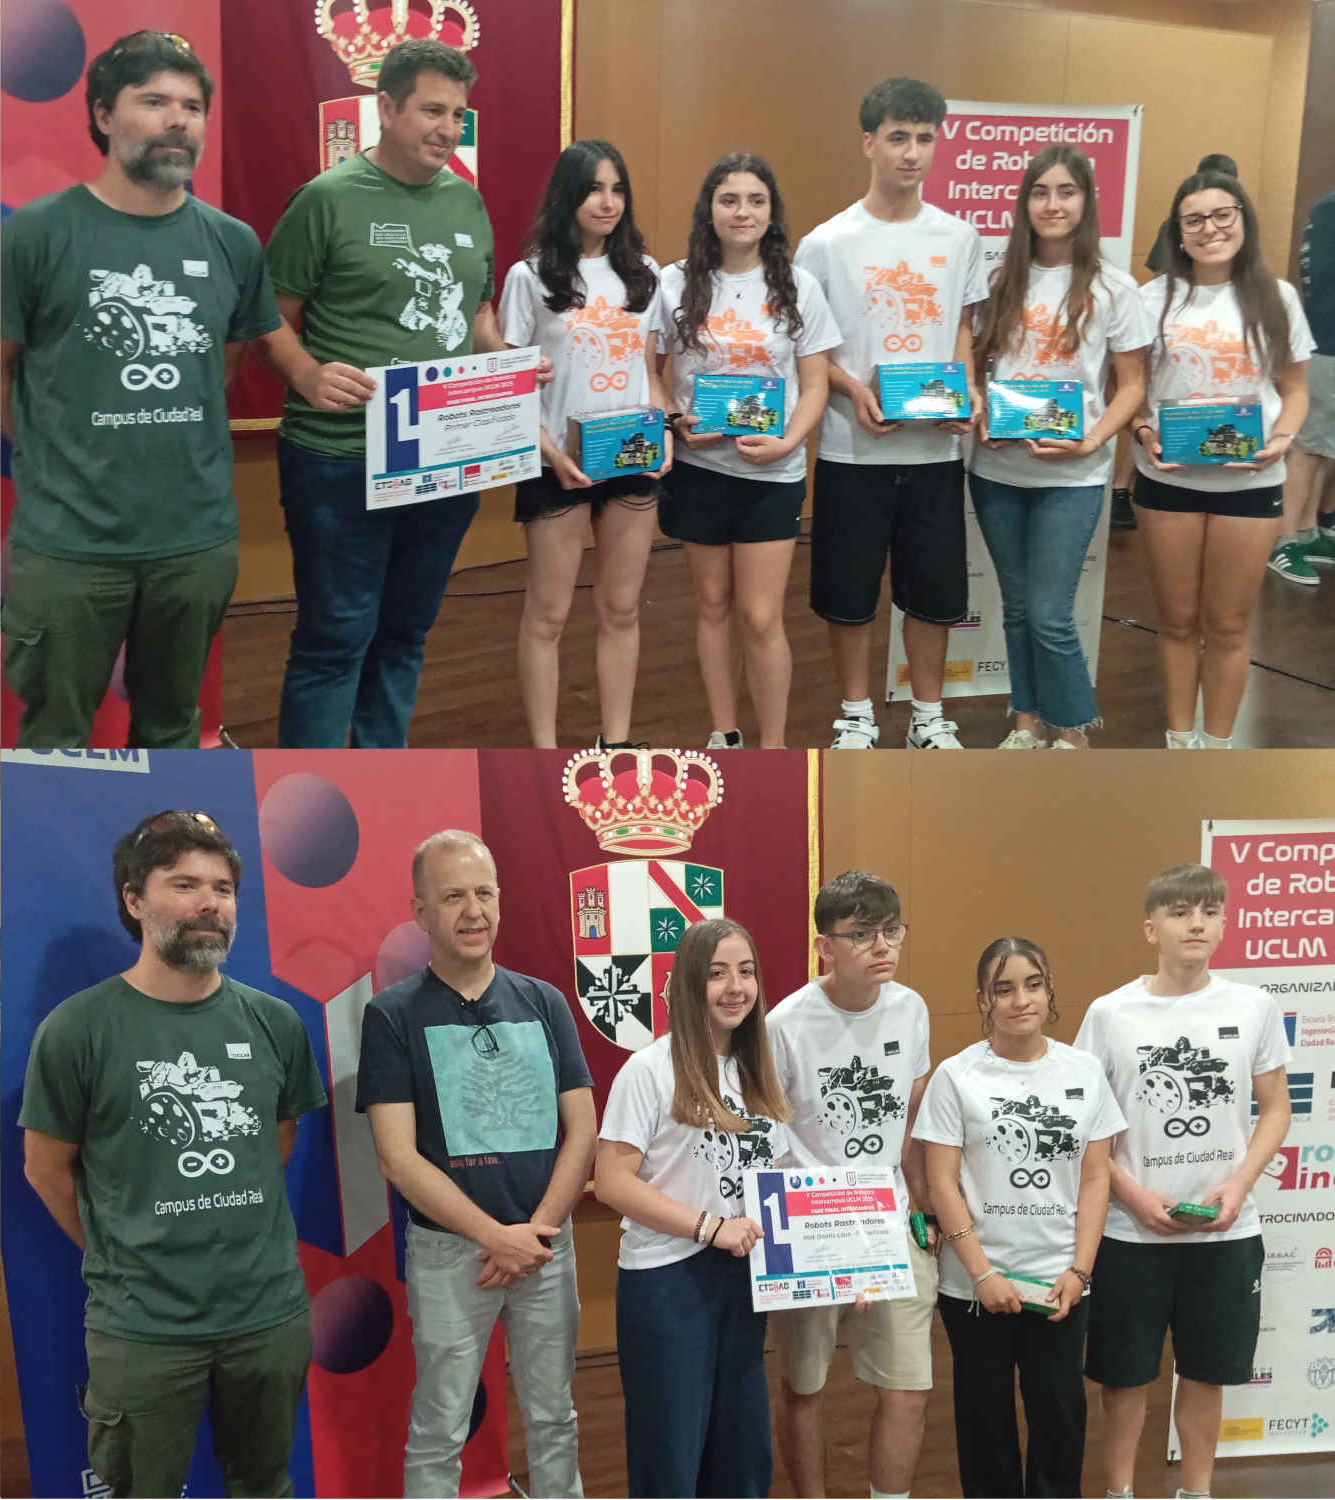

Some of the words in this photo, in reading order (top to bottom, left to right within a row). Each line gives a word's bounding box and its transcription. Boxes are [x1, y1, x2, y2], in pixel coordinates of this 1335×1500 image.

[942, 120, 960, 140] V
[966, 121, 1114, 146] Competición
[956, 149, 986, 170] de
[91, 411, 136, 429] Campus
[137, 408, 152, 423] de
[153, 406, 189, 423] Ciudad
[438, 412, 467, 422] Robots
[469, 402, 522, 417] Rastreadores
[444, 422, 472, 432] Primer
[473, 413, 516, 427] Clasificado
[1230, 843, 1251, 863] V
[1247, 873, 1281, 895] de
[1238, 908, 1334, 928] Interca
[1245, 937, 1327, 960] UCLM
[1301, 1038, 1324, 1047] Ciudad
[466, 1157, 476, 1166] for
[1144, 1156, 1173, 1169] Campus
[1175, 1153, 1185, 1164] de
[1187, 1149, 1215, 1164] Ciudad
[1217, 1149, 1235, 1160] Real
[1301, 1145, 1334, 1163] ro
[155, 1200, 196, 1216] Campus
[198, 1194, 212, 1210] de
[213, 1190, 248, 1208] Ciudad
[249, 1188, 264, 1204] Real
[811, 1190, 846, 1198] Competición
[811, 1197, 845, 1205] Intercampus
[984, 1203, 1015, 1217] Campus
[1017, 1203, 1028, 1215] de
[1030, 1203, 1054, 1216] Ciudad
[1258, 1211, 1334, 1224] TROCINADO
[805, 1220, 832, 1229] Robots
[1269, 1418, 1310, 1430] FECYT
